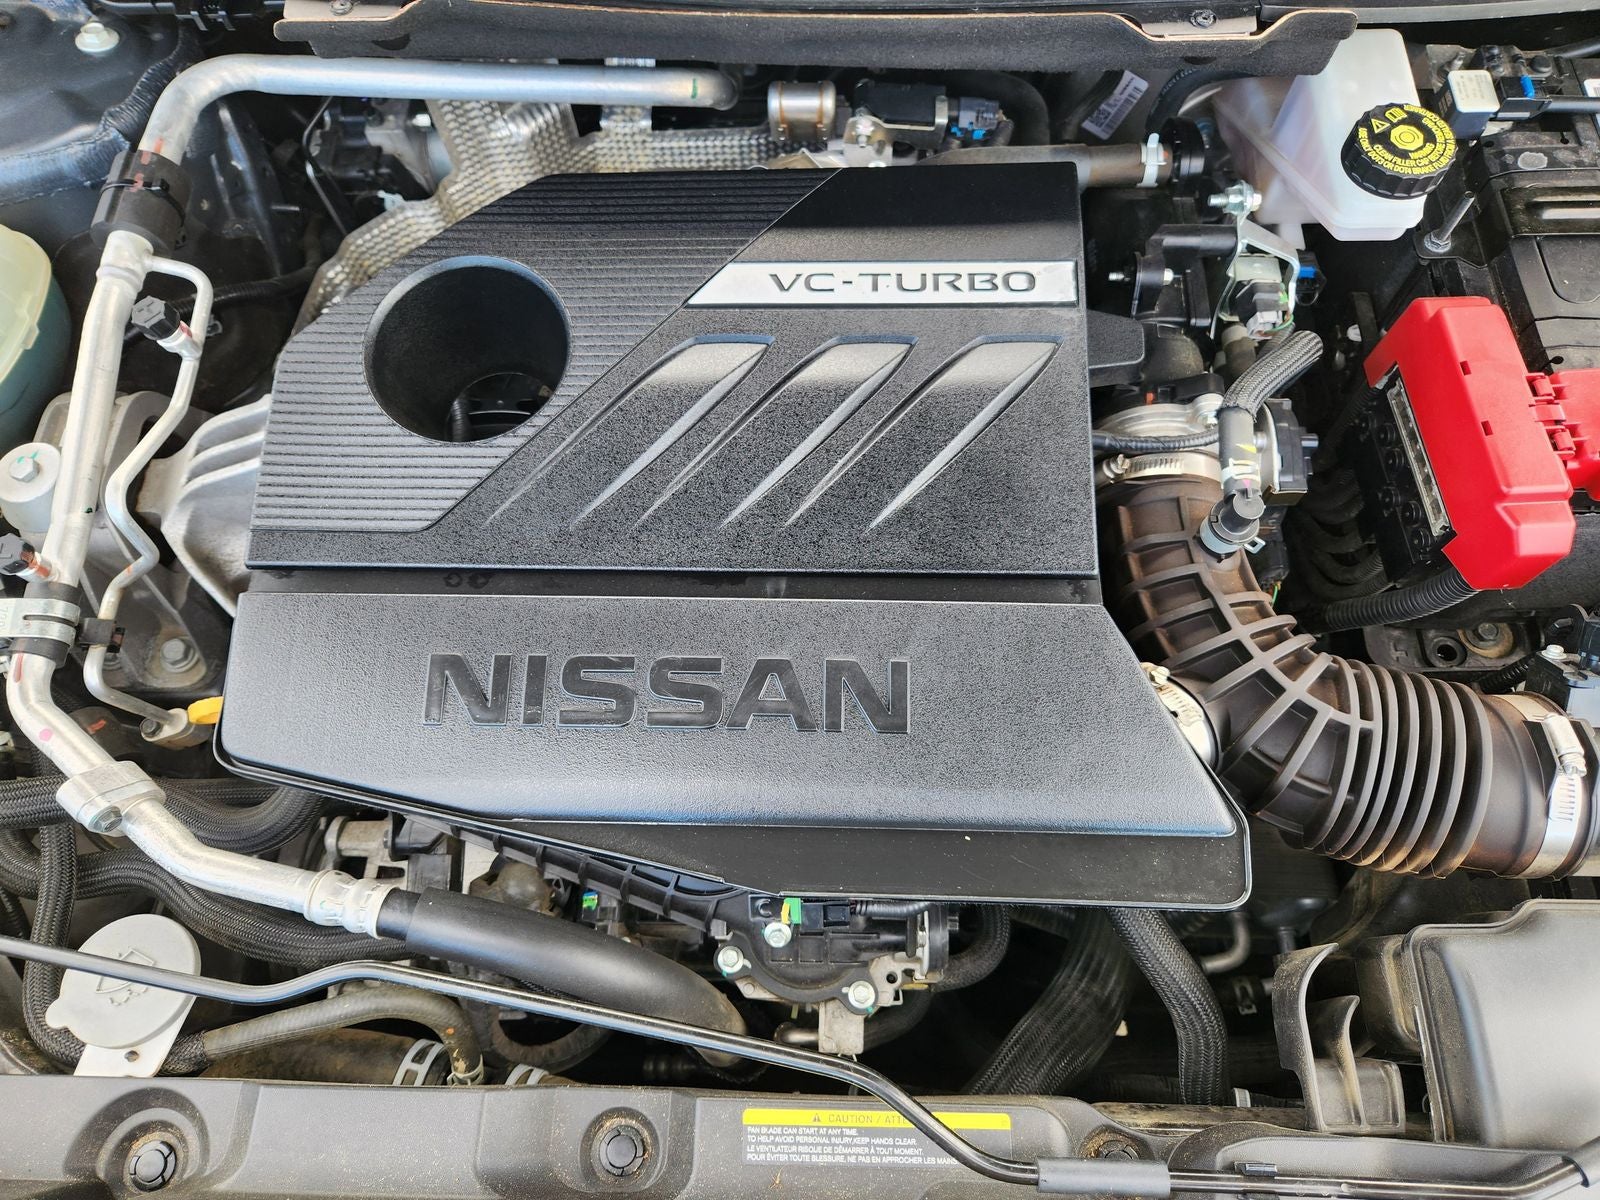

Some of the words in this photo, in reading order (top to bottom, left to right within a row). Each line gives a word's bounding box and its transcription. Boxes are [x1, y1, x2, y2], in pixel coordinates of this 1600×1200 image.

[1358, 127, 1368, 138] USE
[1359, 138, 1371, 152] ONLY
[1445, 143, 1456, 159] FROM
[1368, 151, 1385, 165] DOT3
[1373, 144, 1394, 161] CLEAN
[1393, 156, 1417, 168] FILLER
[1416, 157, 1431, 167] CAP
[1427, 142, 1446, 162] BEFORE
[1383, 161, 1394, 170] OR
[1434, 156, 1450, 169] FLUID
[1393, 165, 1412, 174] DOT4
[1411, 164, 1435, 175] BRAKE
[768, 271, 1036, 293] VC-TURBO
[422, 653, 911, 735] NISSAN
[828, 1114, 873, 1124] CAUTION
[747, 1126, 760, 1134] FAN
[783, 1127, 798, 1135] CAN
[798, 1127, 818, 1135] START
[819, 1127, 828, 1135] AT
[828, 1127, 842, 1135] ANY
[747, 1134, 756, 1143] TO
[757, 1134, 774, 1143] HELP
[774, 1135, 795, 1143] AVOID
[795, 1135, 830, 1144] PERSONAL
[870, 1137, 894, 1145] HANDS
[894, 1137, 917, 1146] CLEAR.
[746, 1144, 755, 1153] LE
[756, 1144, 798, 1154] VENTILATEUR
[798, 1145, 823, 1154] RISQUE
[823, 1146, 833, 1154] DE
[876, 1146, 894, 1155] TOUT
[894, 1147, 924, 1156] MOMENT.
[746, 1153, 766, 1161] POUR
[789, 1153, 811, 1162] TOUTE
[847, 1155, 857, 1164] NE
[857, 1155, 871, 1164] PAS
[871, 1156, 881, 1164] EN
[881, 1156, 923, 1165] APPROCHER
[923, 1156, 936, 1165] LES
